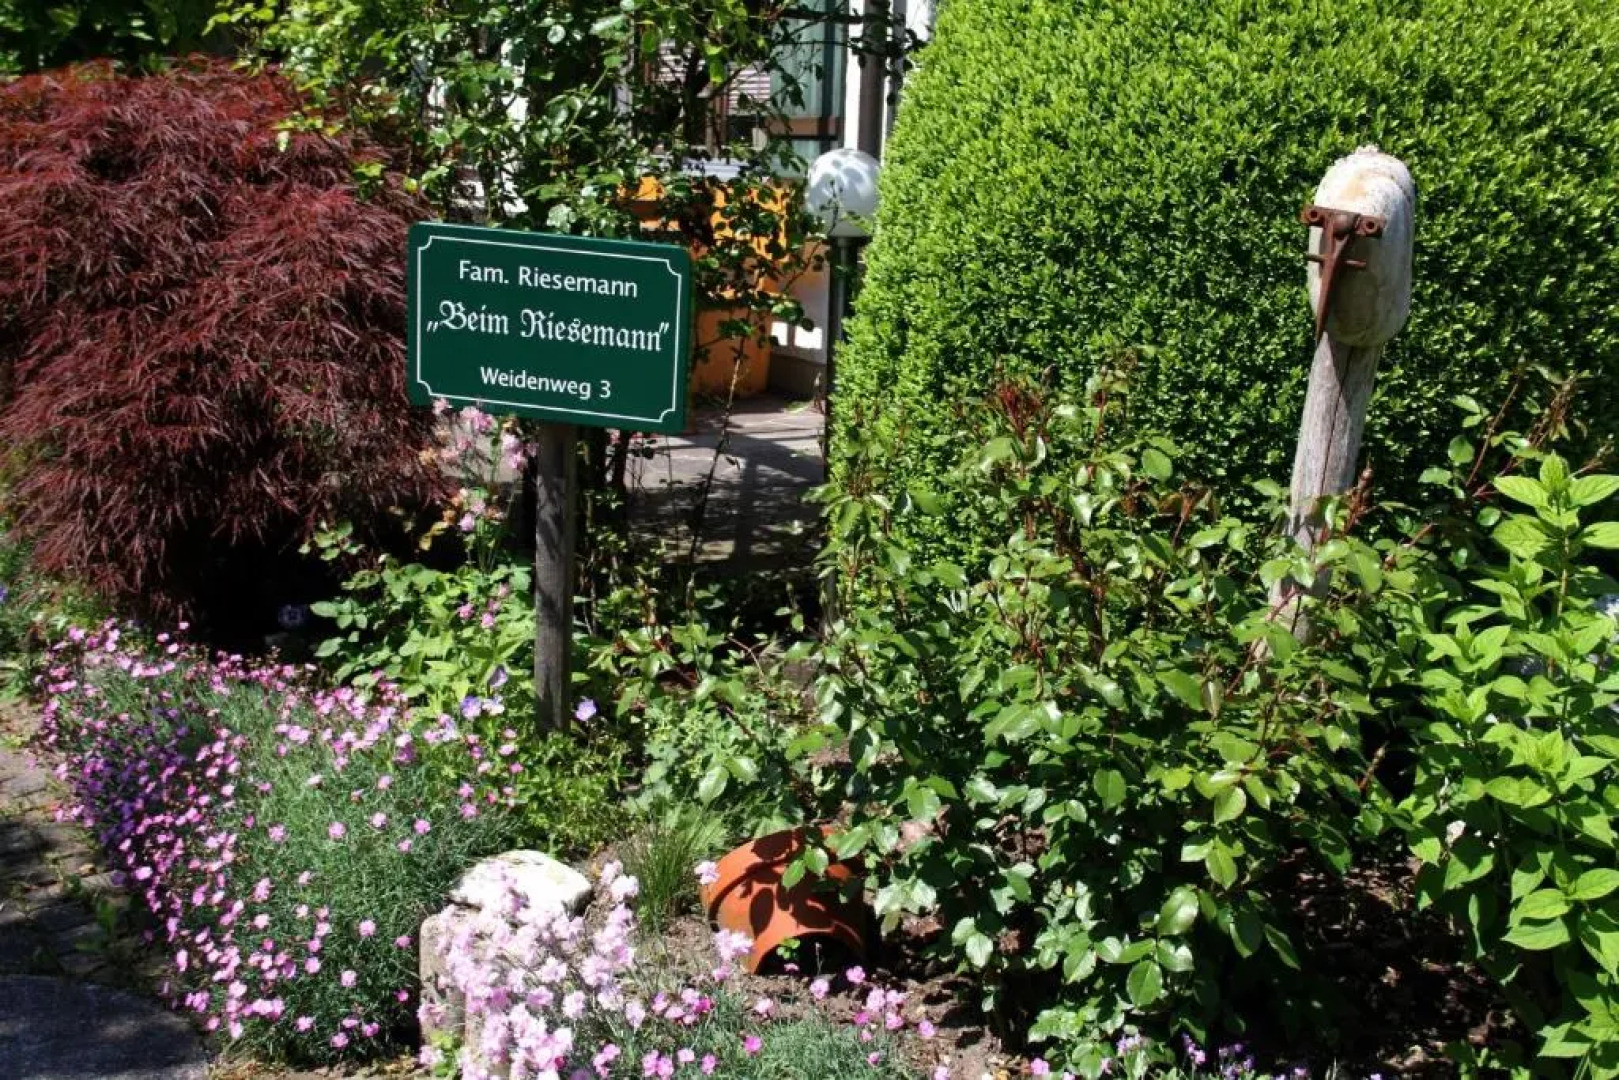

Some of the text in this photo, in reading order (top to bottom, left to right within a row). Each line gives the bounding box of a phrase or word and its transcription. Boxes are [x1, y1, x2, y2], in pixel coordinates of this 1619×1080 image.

[459, 260, 638, 298] Fam. Riesemann
[480, 366, 611, 400] Weidenweg 3
